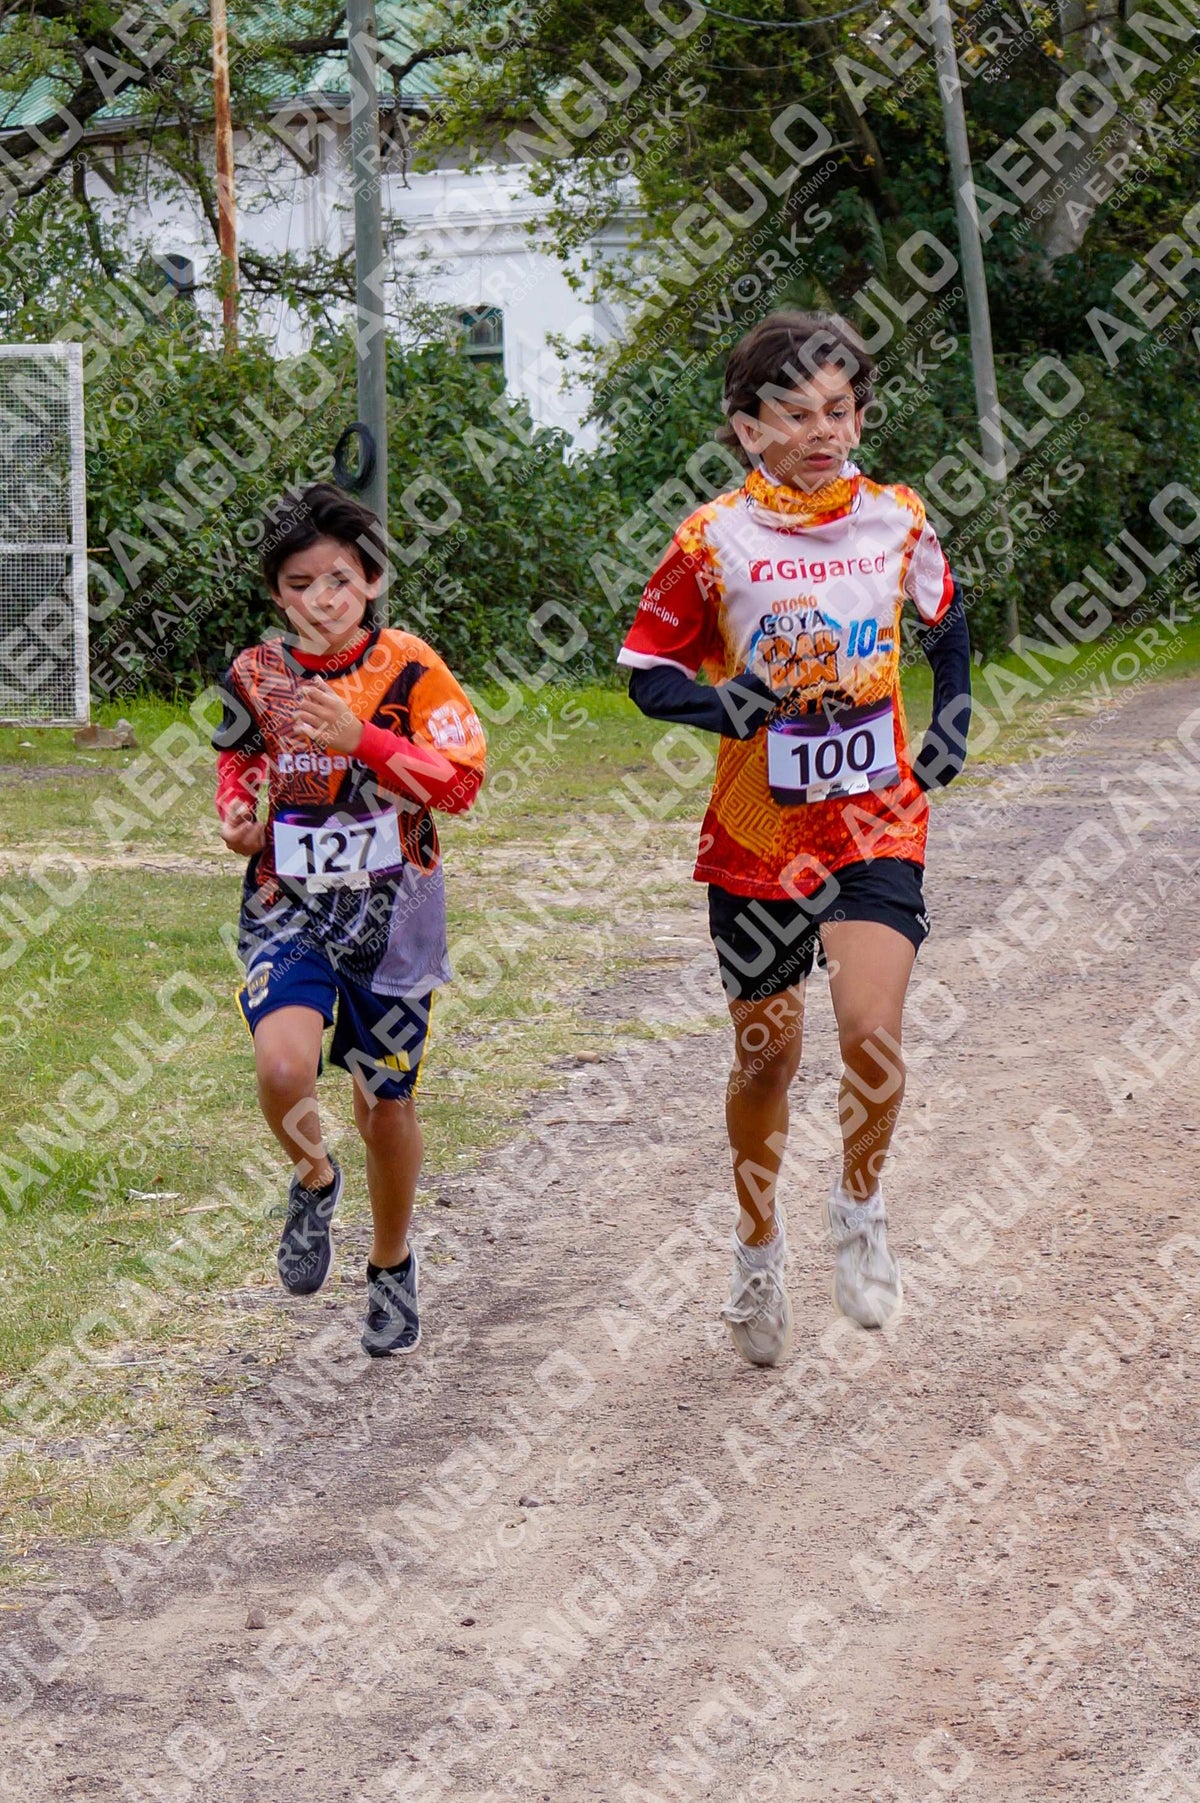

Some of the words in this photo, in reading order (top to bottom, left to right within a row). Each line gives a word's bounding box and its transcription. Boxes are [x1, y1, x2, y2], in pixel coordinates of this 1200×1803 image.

[776, 551, 886, 584] Gigared
[759, 610, 827, 636] GOYA
[846, 617, 878, 659] 10
[791, 730, 876, 786] 100
[298, 826, 377, 875] 127
